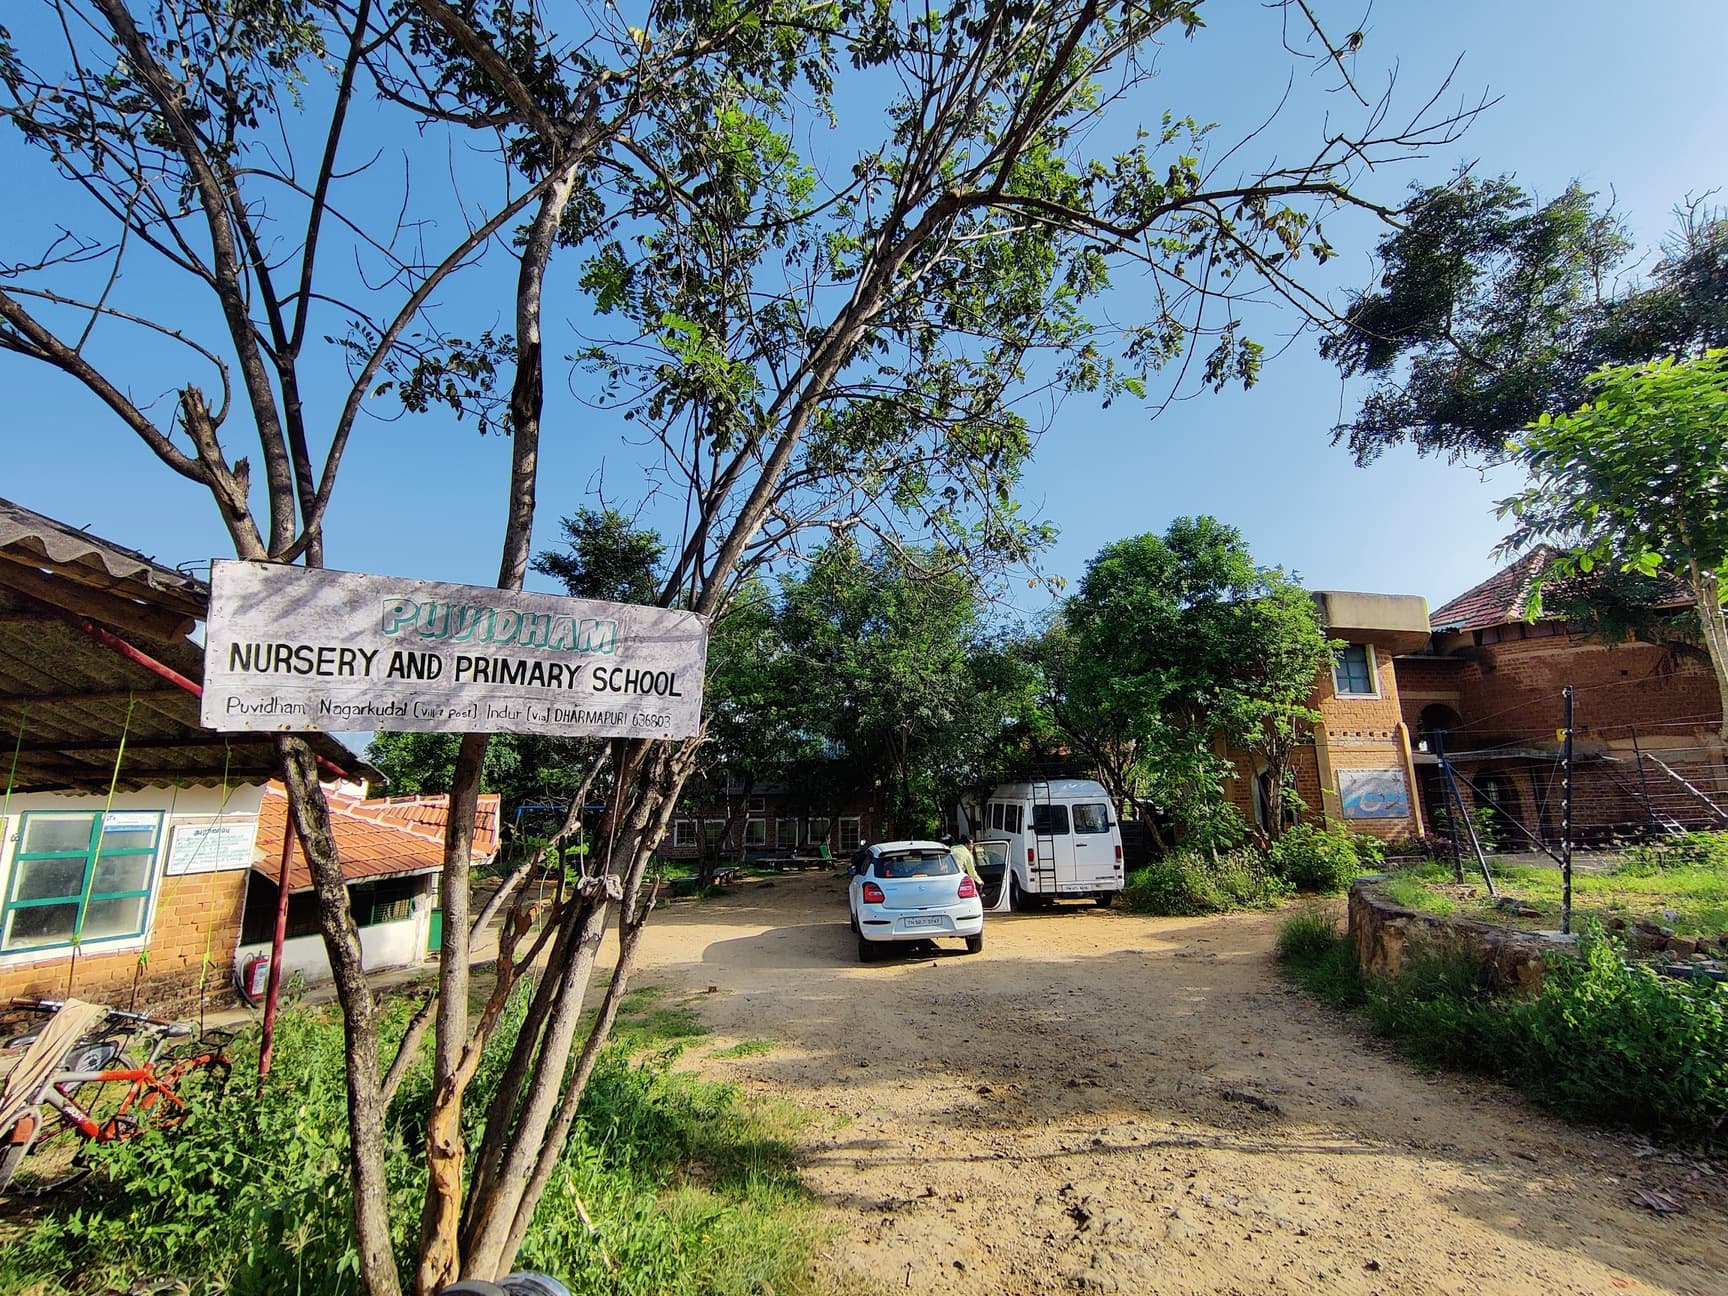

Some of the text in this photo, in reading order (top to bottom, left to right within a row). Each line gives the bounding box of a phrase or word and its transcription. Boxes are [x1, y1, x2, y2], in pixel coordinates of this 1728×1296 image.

[382, 598, 617, 655] PUVIDHAM
[229, 642, 682, 698] NURSERY AND PRIMARY SCHOOL
[226, 697, 306, 715] Puvidham
[319, 699, 408, 720] Nagarkudal
[487, 704, 522, 720] Indur
[554, 708, 628, 726] DHARMAPURI
[631, 713, 671, 728] 636803
